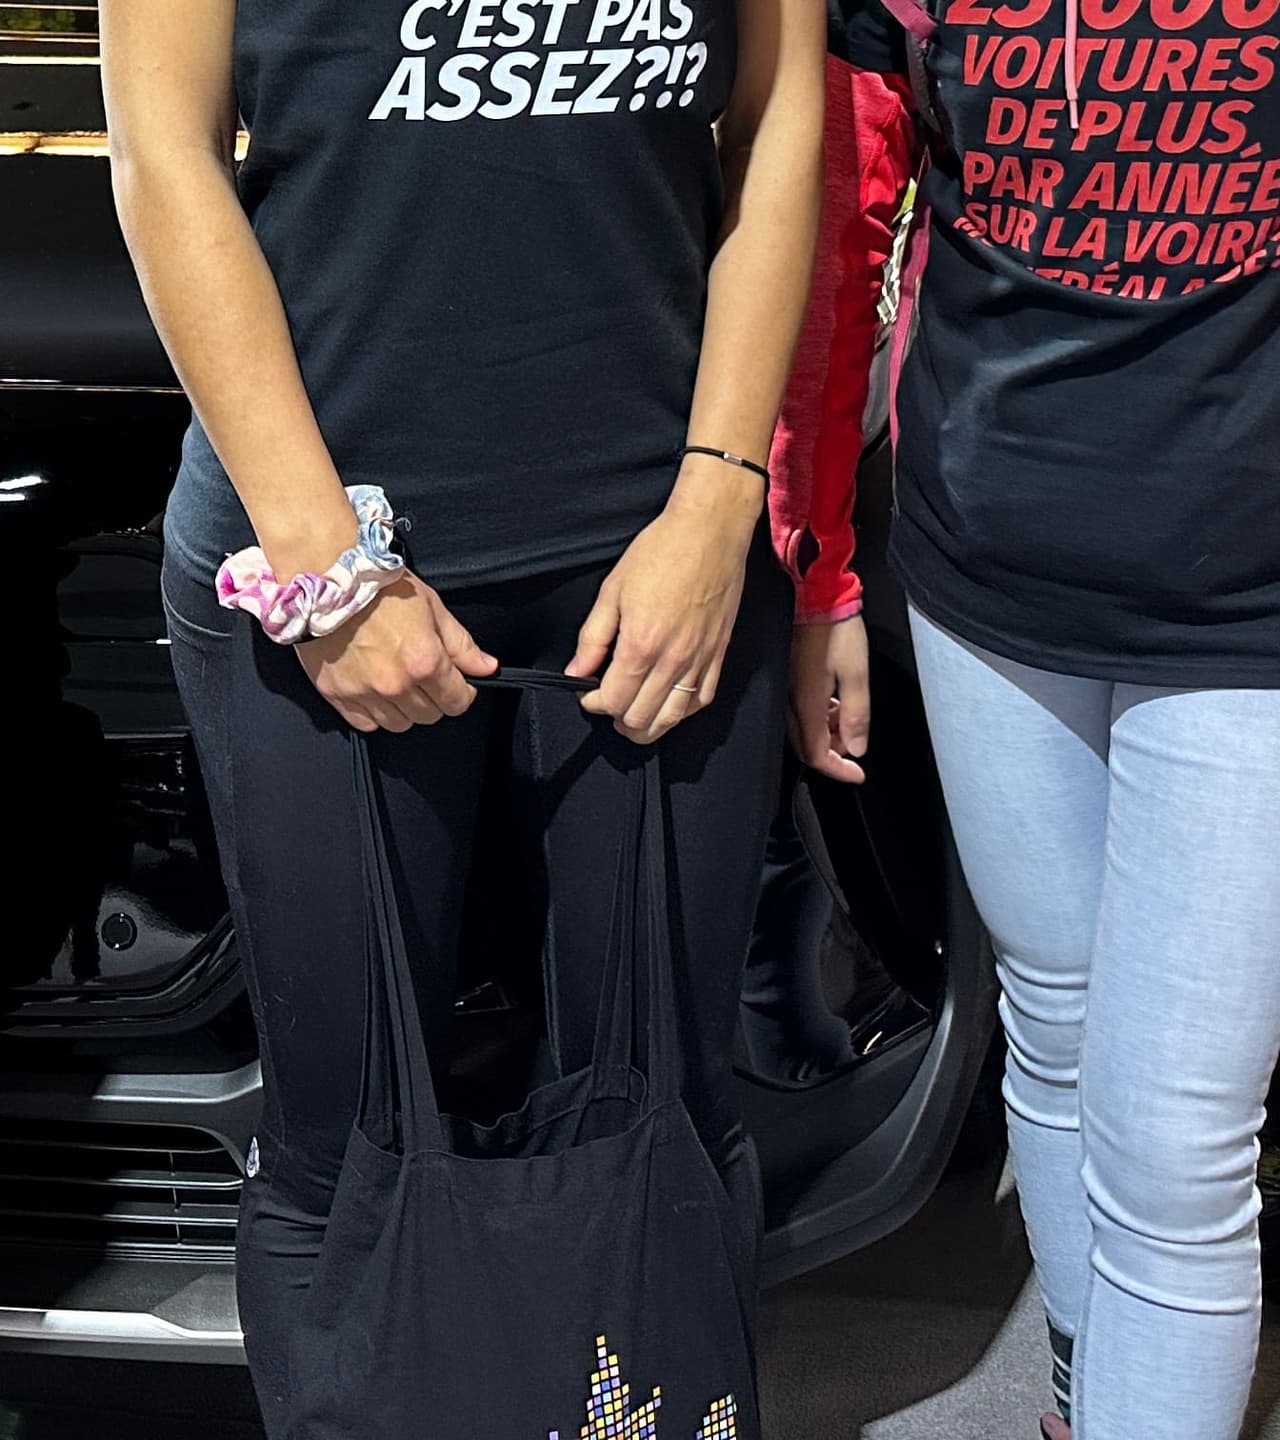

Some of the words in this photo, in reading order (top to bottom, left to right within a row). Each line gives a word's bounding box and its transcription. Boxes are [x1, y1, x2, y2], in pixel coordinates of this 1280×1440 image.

[367, 42, 708, 122] ASSEZ?!?
[985, 95, 1067, 150] DE
[1070, 99, 1256, 155] PLUS
[963, 150, 1065, 209] PAR
[965, 202, 1038, 253] SUR
[1041, 216, 1108, 261] LA
